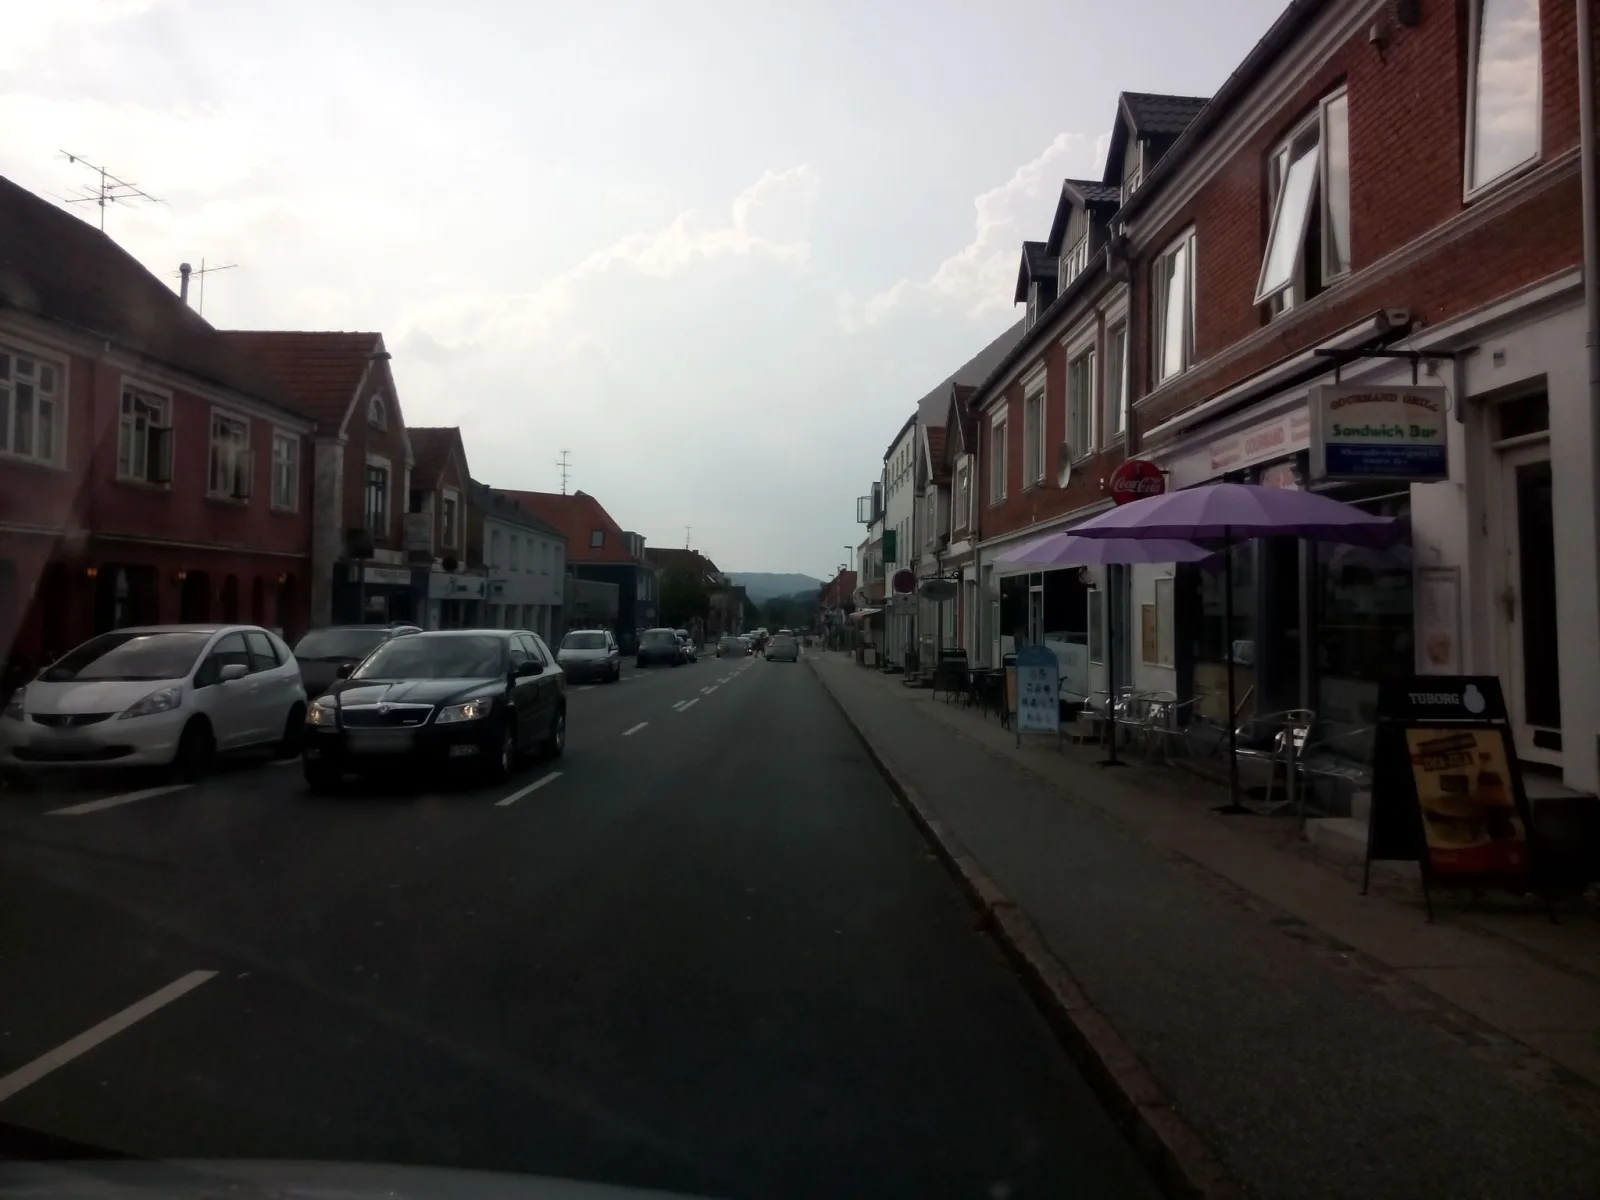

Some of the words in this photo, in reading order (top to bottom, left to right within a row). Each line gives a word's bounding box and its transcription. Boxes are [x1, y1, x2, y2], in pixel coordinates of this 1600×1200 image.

[1330, 393, 1397, 410] GOURMAND
[1402, 395, 1439, 412] GRILL
[1333, 424, 1404, 438] Sandwich
[1410, 425, 1437, 438] Bar
[1408, 692, 1460, 705] TUBORG
